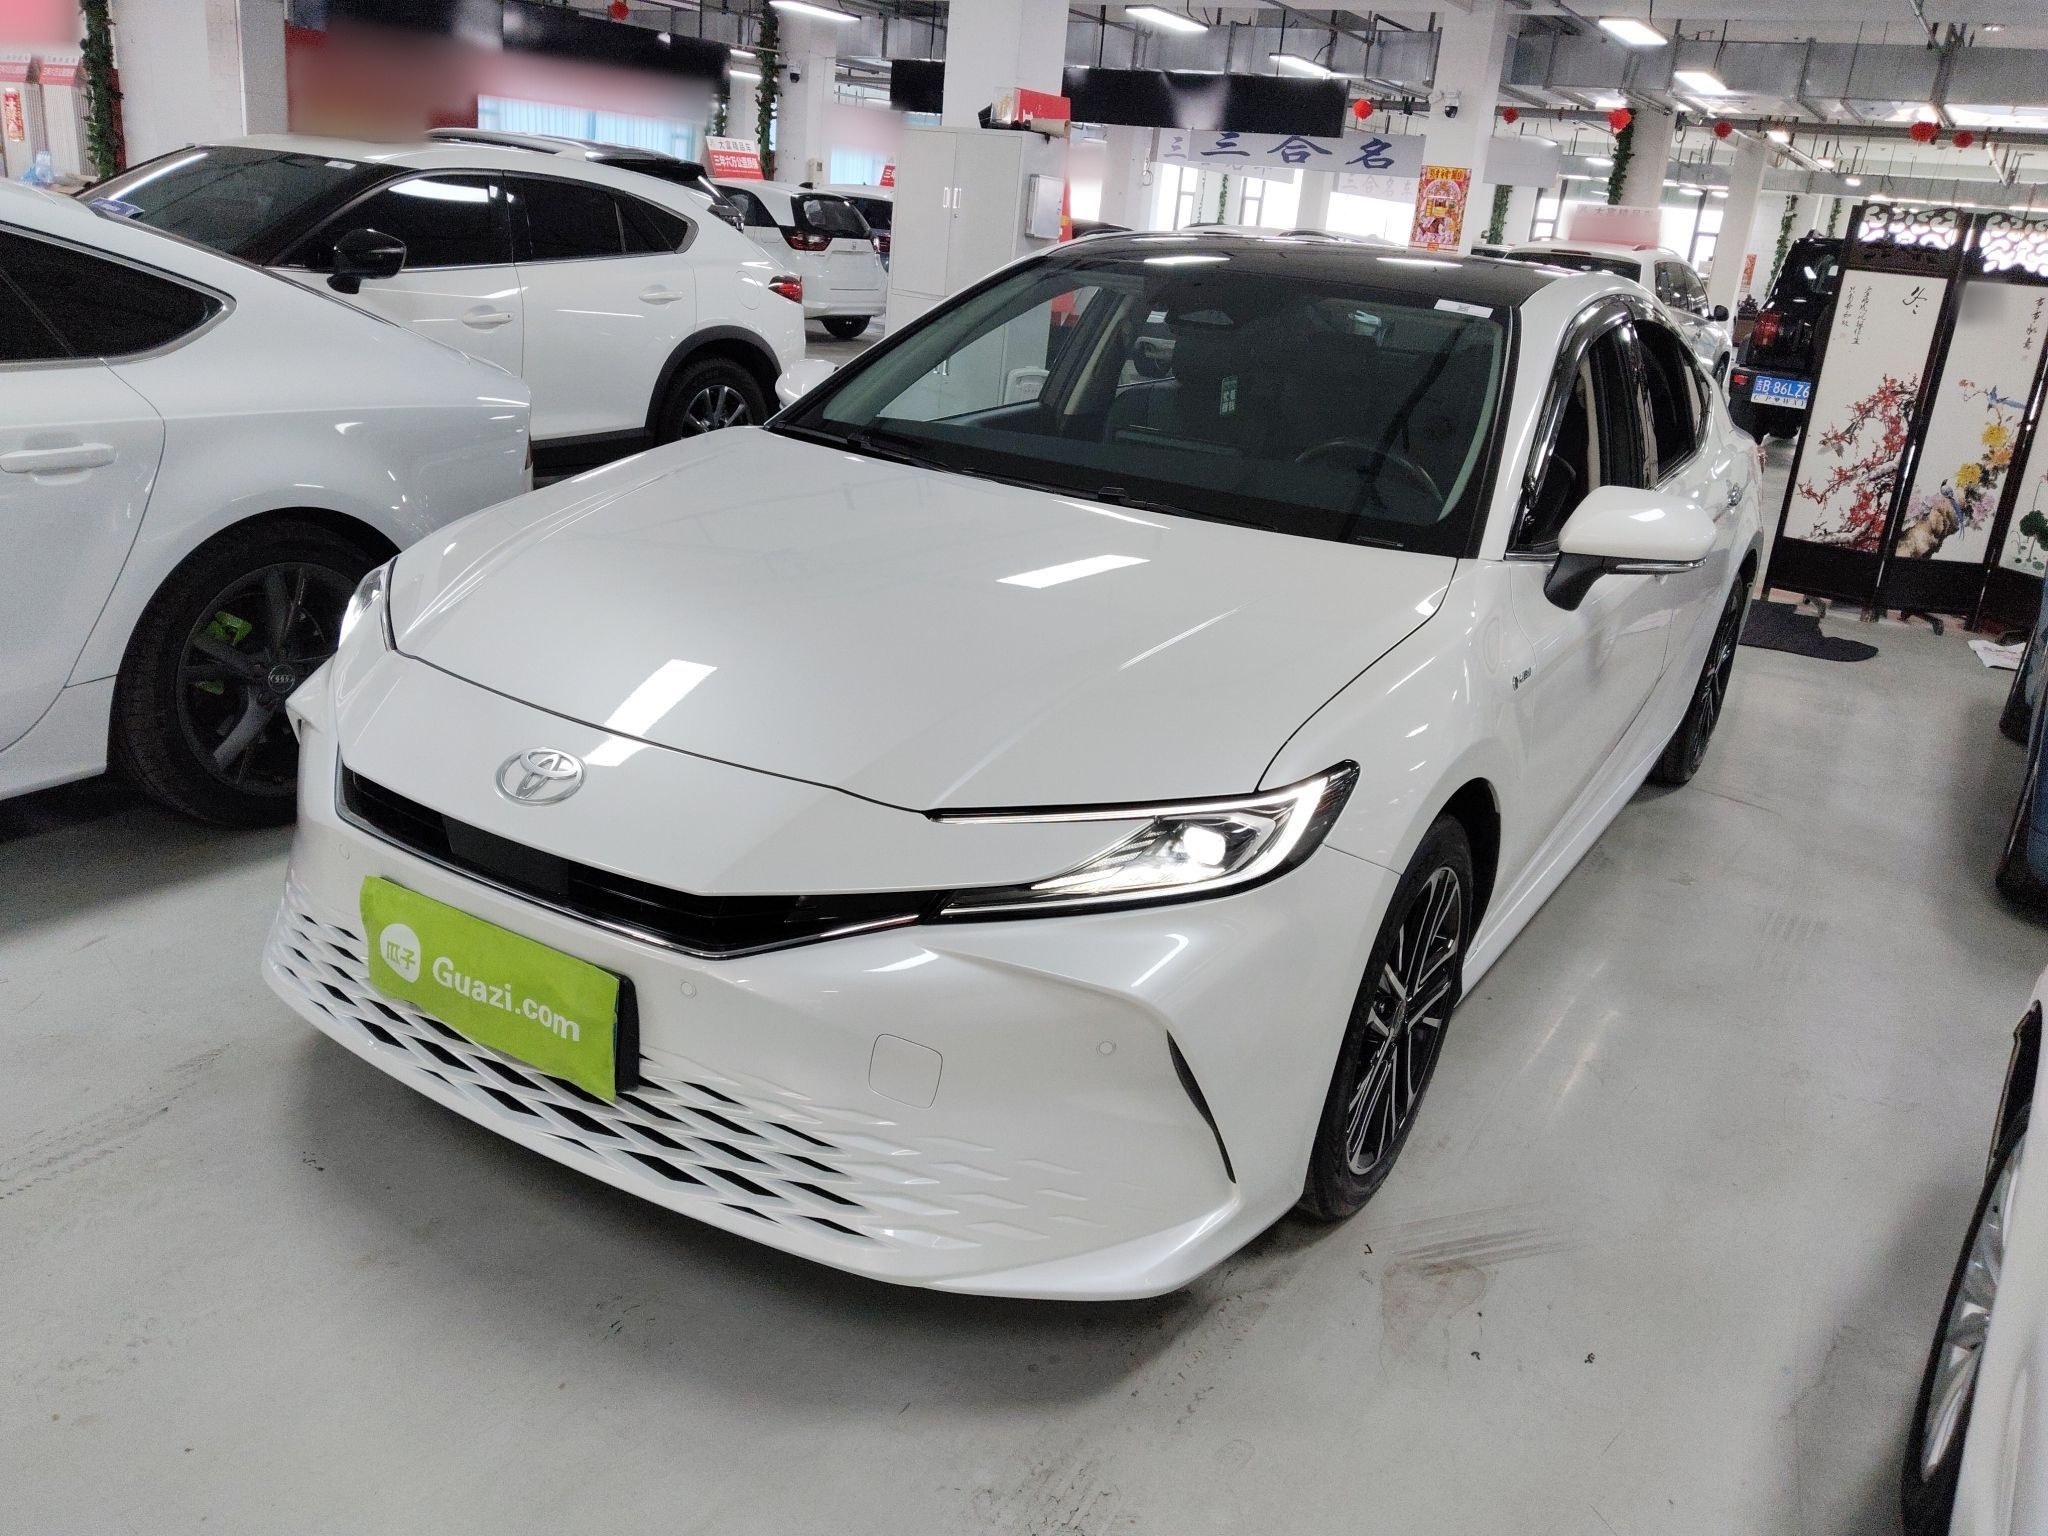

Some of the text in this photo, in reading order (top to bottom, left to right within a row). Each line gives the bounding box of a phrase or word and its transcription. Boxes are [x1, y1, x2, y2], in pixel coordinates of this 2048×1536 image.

[1200, 132, 1396, 170] 三合名
[1902, 286, 1928, 315] 冬
[386, 940, 416, 971] 瓜子
[432, 956, 581, 1042] Guazi.com
